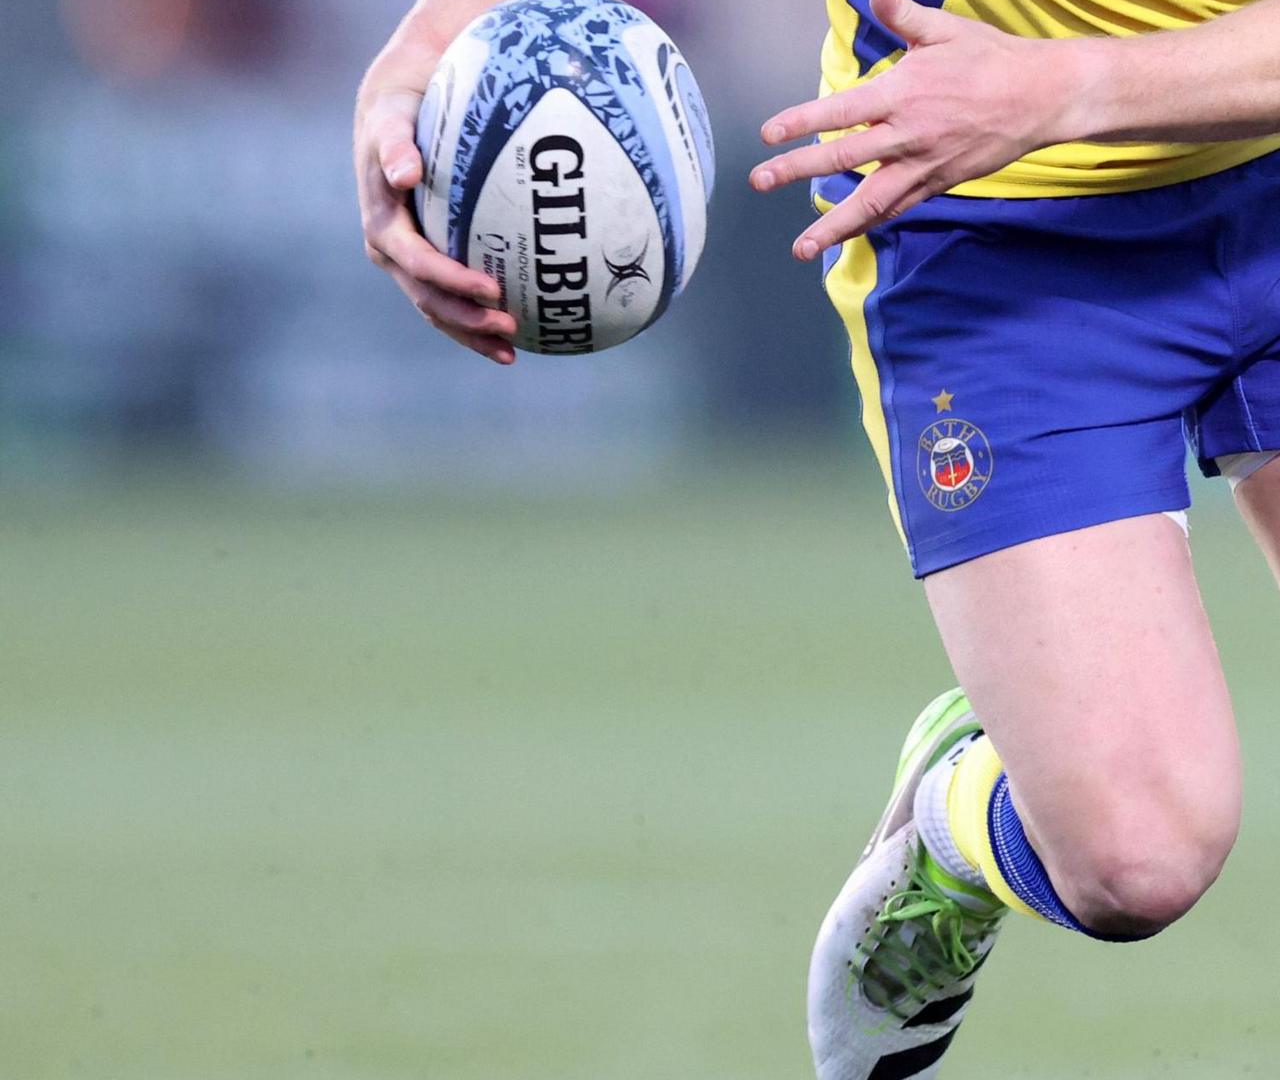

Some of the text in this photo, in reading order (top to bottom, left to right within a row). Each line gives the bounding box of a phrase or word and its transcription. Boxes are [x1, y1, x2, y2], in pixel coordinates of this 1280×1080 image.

[515, 146, 526, 170] SIZE
[483, 253, 494, 278] RUG
[517, 232, 529, 282] INNOVO
[920, 421, 977, 453] BATH
[927, 467, 989, 508] RUGBY
